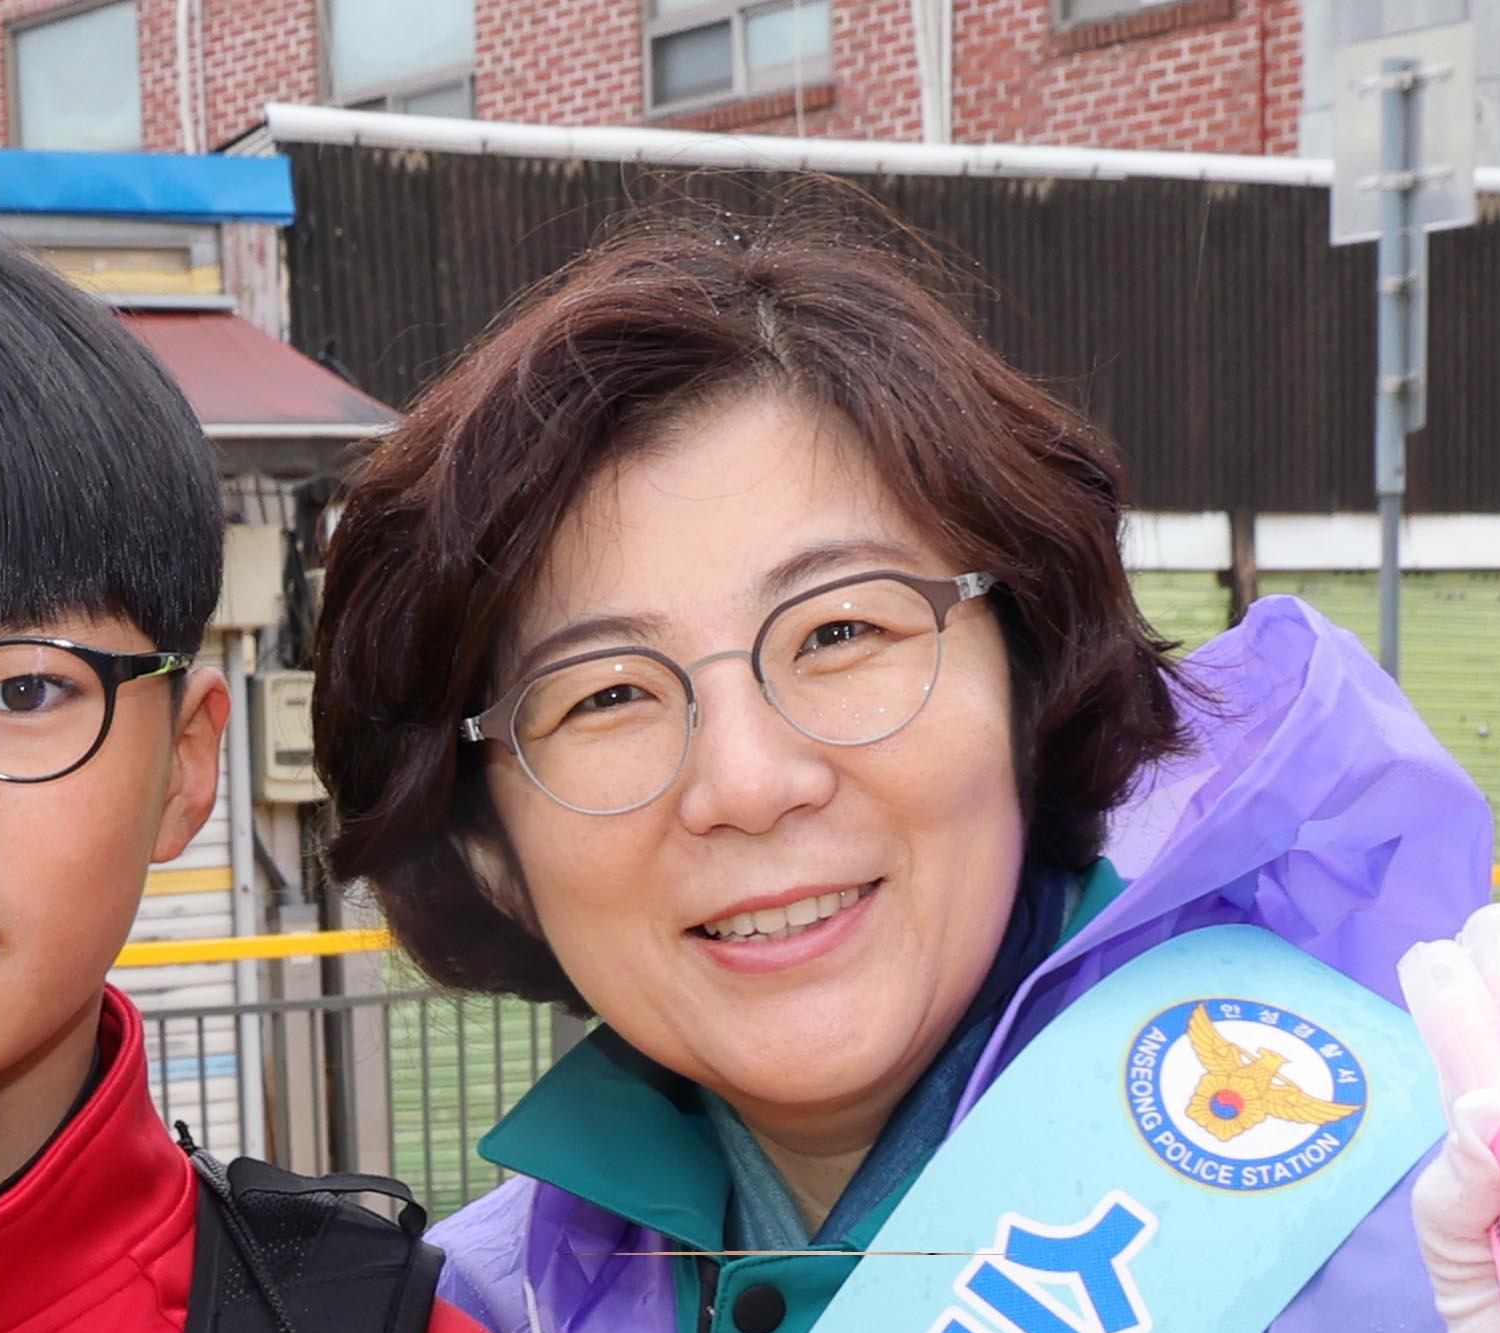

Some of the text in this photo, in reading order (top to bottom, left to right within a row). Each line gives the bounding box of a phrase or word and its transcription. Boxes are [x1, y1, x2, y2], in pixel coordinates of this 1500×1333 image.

[1130, 1026, 1341, 1187] ANSEONG POLICE STATION
